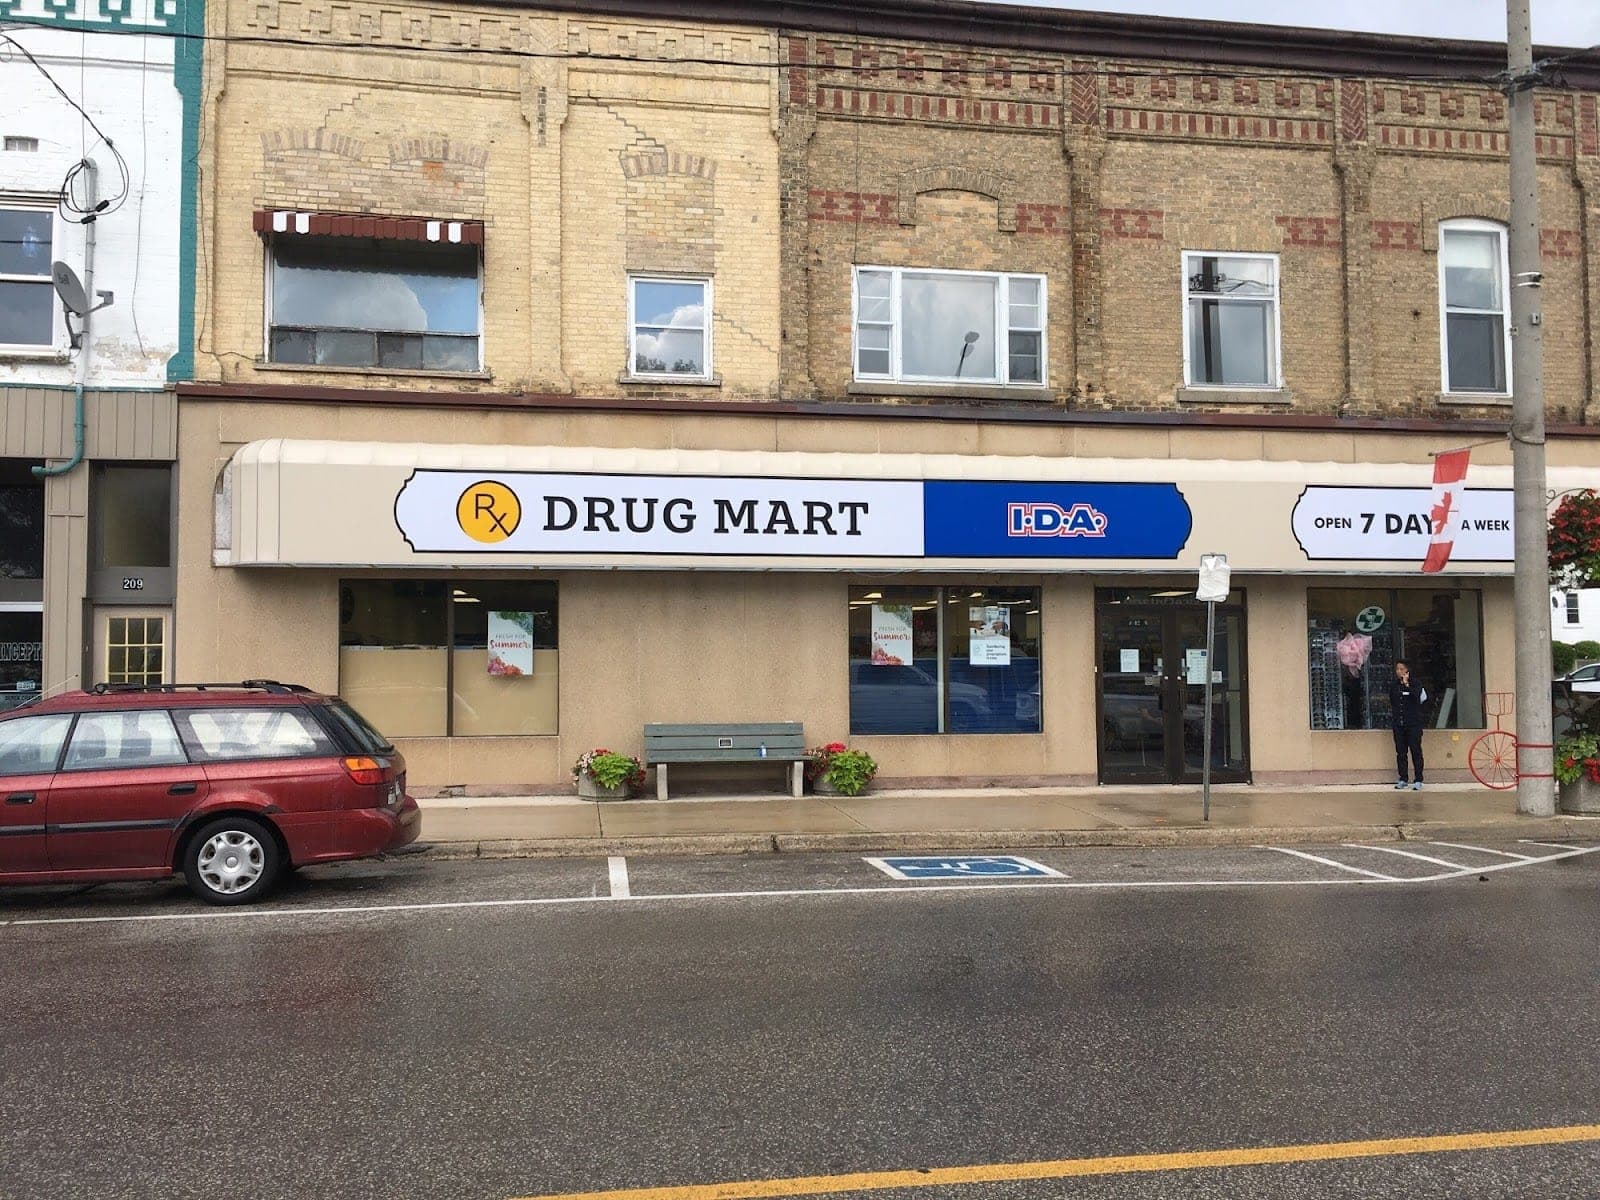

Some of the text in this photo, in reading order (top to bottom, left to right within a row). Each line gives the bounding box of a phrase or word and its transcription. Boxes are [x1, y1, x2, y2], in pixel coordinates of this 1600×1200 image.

[543, 495, 697, 534] DRUG
[713, 499, 869, 536] MART
[1314, 513, 1510, 534] OPEN 7 DAY A WEEK
[123, 578, 144, 590] 209
